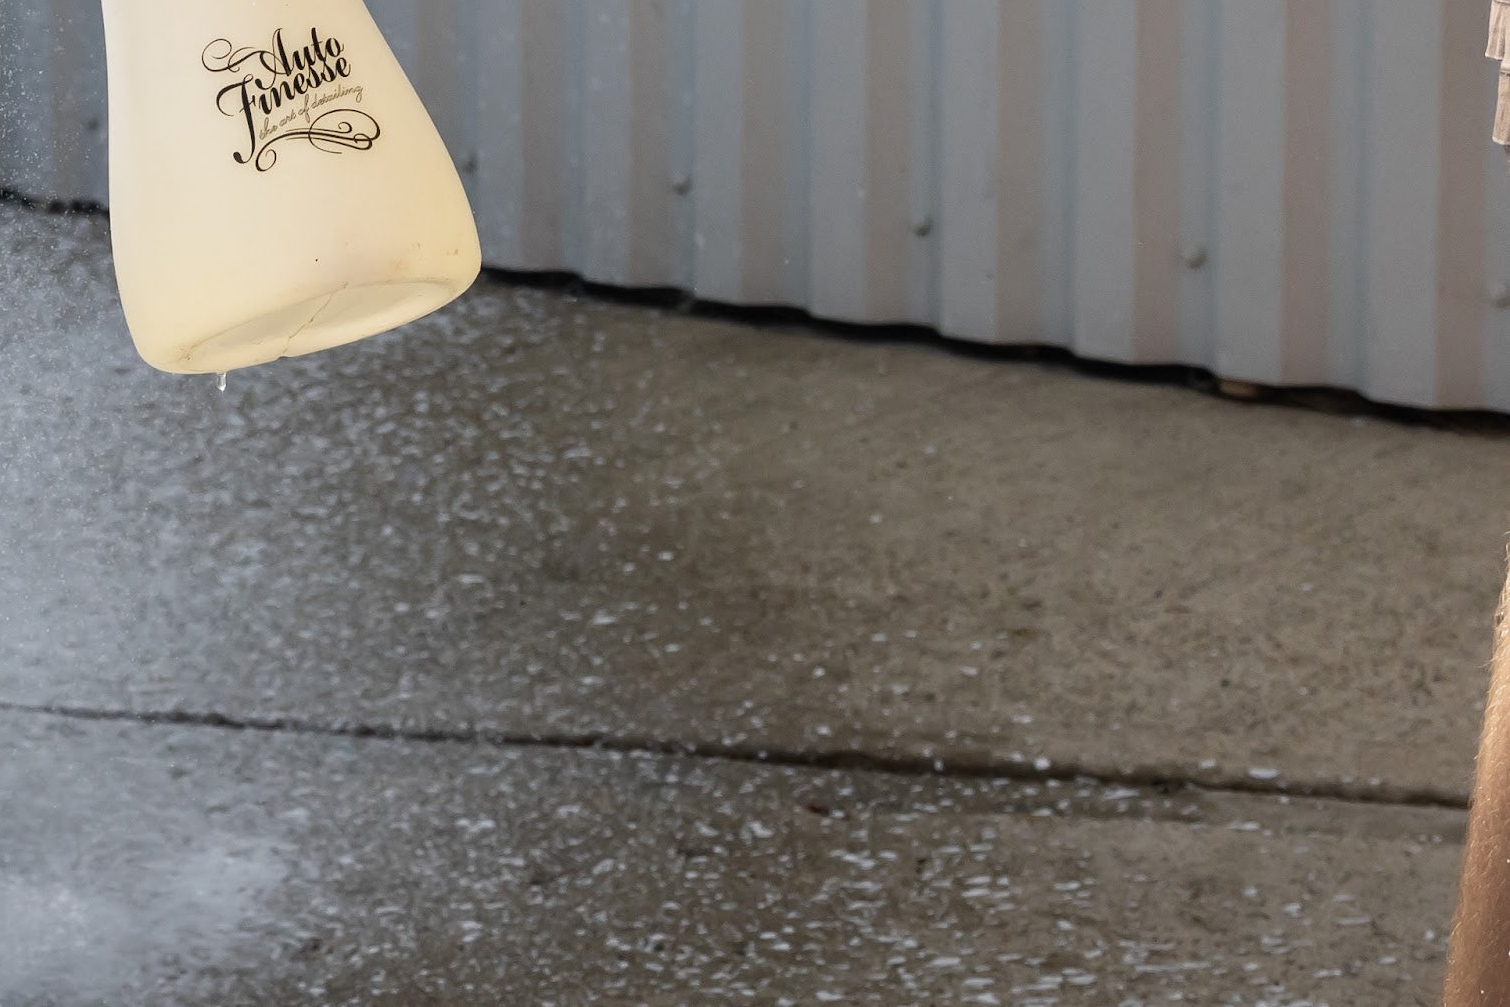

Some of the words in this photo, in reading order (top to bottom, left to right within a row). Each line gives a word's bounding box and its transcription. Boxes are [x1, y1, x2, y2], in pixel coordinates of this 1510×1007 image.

[201, 27, 345, 90] Auto
[216, 57, 351, 164] Finesse
[259, 117, 278, 140] the
[279, 108, 297, 127] art
[298, 93, 310, 123] of
[311, 83, 364, 108] detailing
